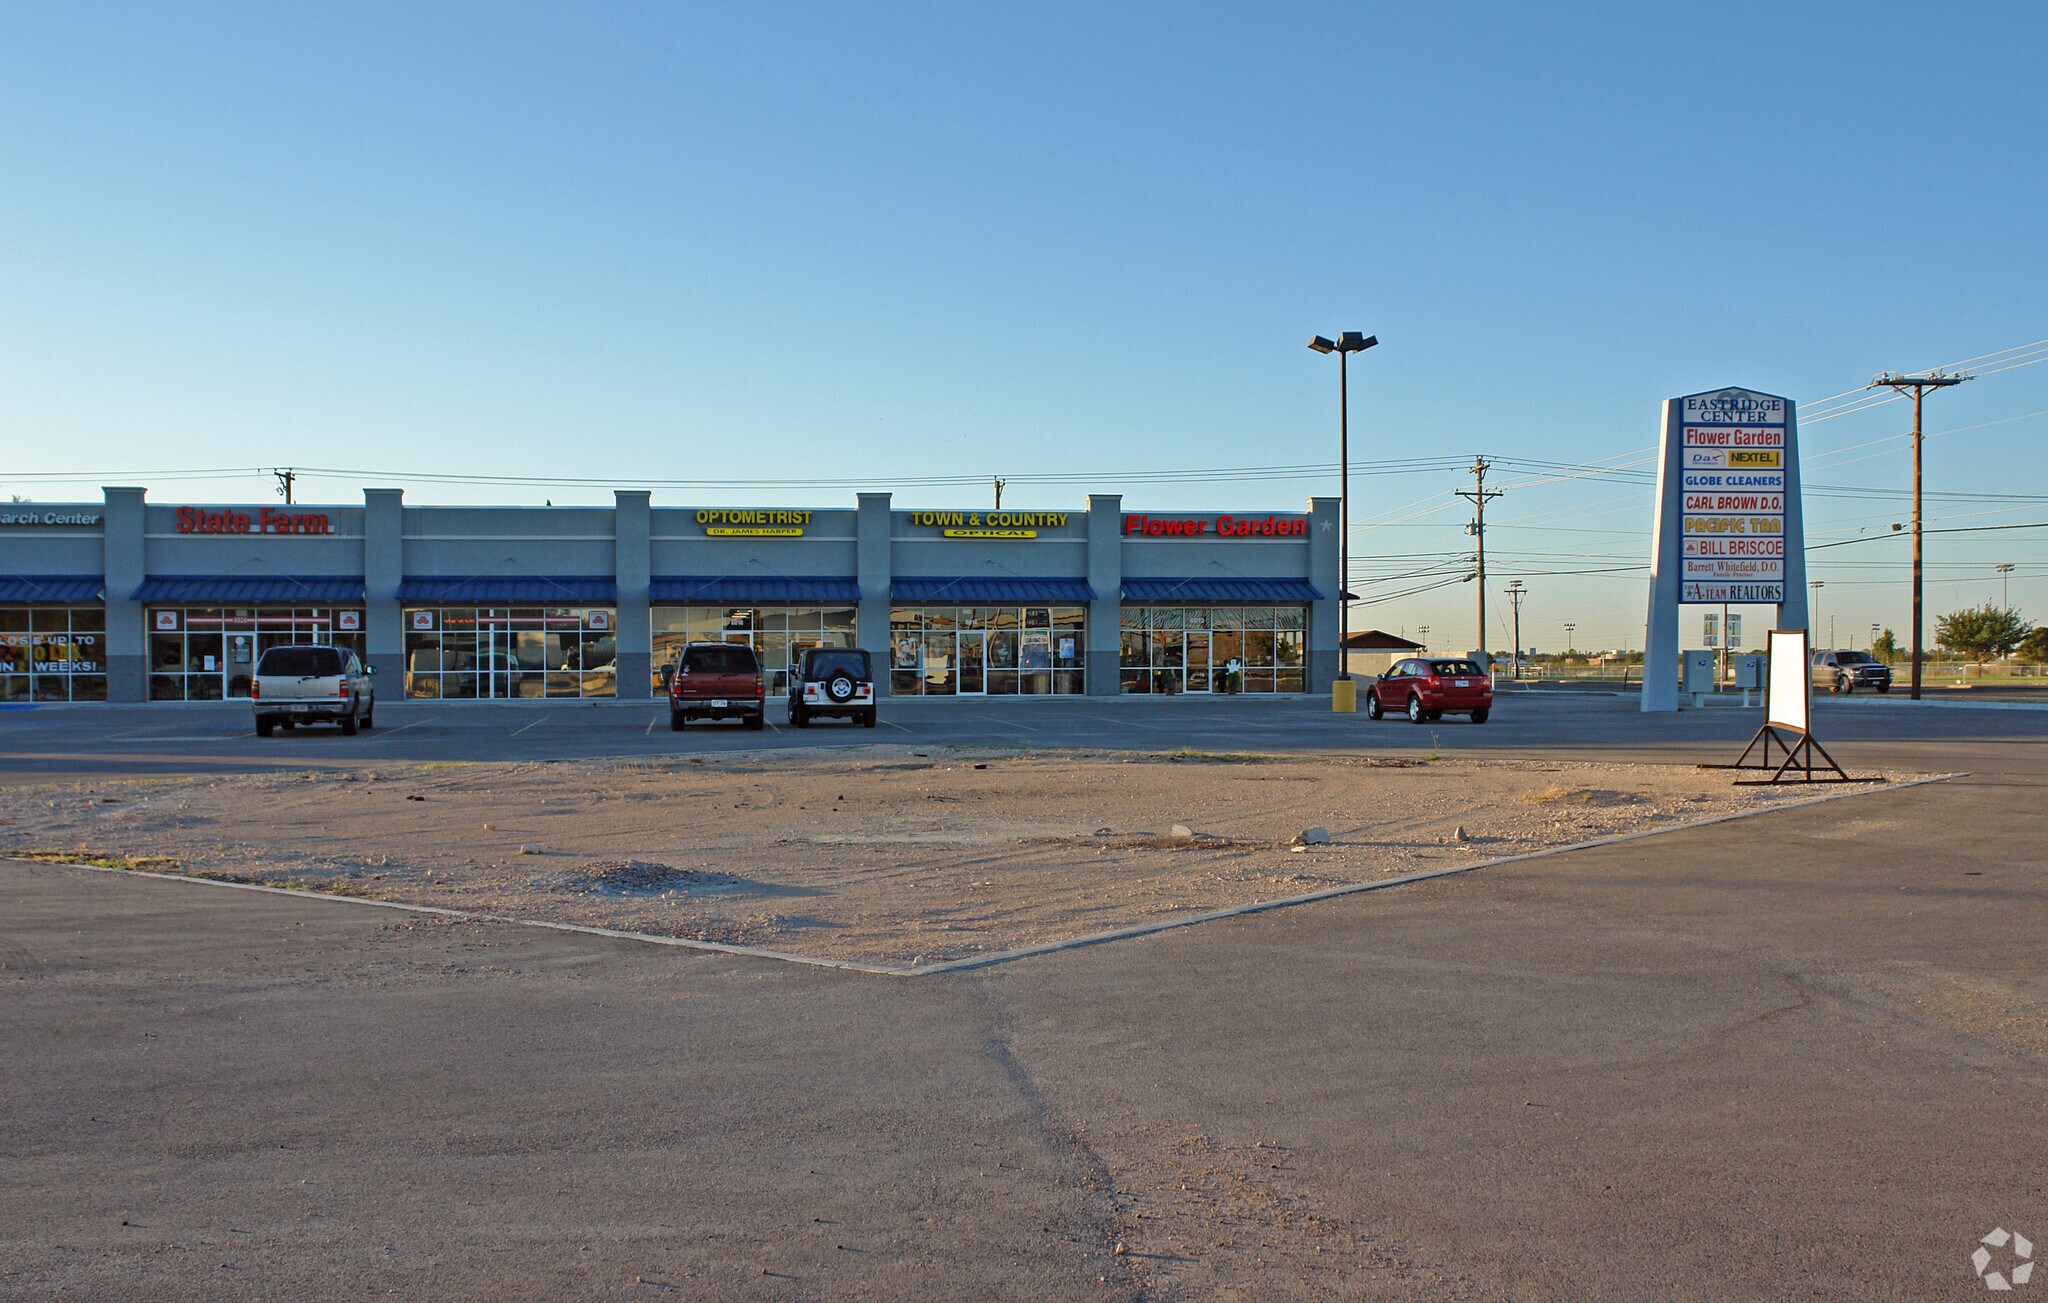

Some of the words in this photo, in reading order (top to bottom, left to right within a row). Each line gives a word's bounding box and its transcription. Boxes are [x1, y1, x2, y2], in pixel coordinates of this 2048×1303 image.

[1687, 399, 1780, 411] EASTRIDGE
[1701, 411, 1767, 422] CENTER
[1686, 429, 1731, 445] Flower
[1734, 429, 1781, 446] Garden
[1731, 452, 1774, 463] NEXTEL
[1685, 476, 1723, 486] GLOBE
[1726, 476, 1782, 486] CLEANERS
[1686, 496, 1714, 510] CARL
[1717, 496, 1758, 510] BROWN
[1760, 496, 1782, 510] D.O.
[0, 513, 39, 525] arch
[44, 512, 99, 525] Center
[175, 506, 250, 533] State
[259, 507, 329, 533] Farm
[696, 510, 812, 524] OPTOMETRIST
[912, 512, 964, 526] TOWN
[968, 512, 981, 526] &
[985, 513, 1069, 527] COUNTRY
[1126, 515, 1208, 536] Flower
[1216, 515, 1306, 536] Garden
[1684, 517, 1745, 533] PACIFIC
[1700, 540, 1726, 555] BILL
[1729, 540, 1783, 555] BRISCOE
[1687, 561, 1714, 572] Barrett
[1761, 561, 1779, 572] D.O.
[1692, 583, 1727, 600] A-TEAM
[1730, 585, 1781, 600] REALTORS
[47, 636, 67, 645] UP
[75, 636, 95, 645] TO
[34, 662, 97, 672] WEEKS!
